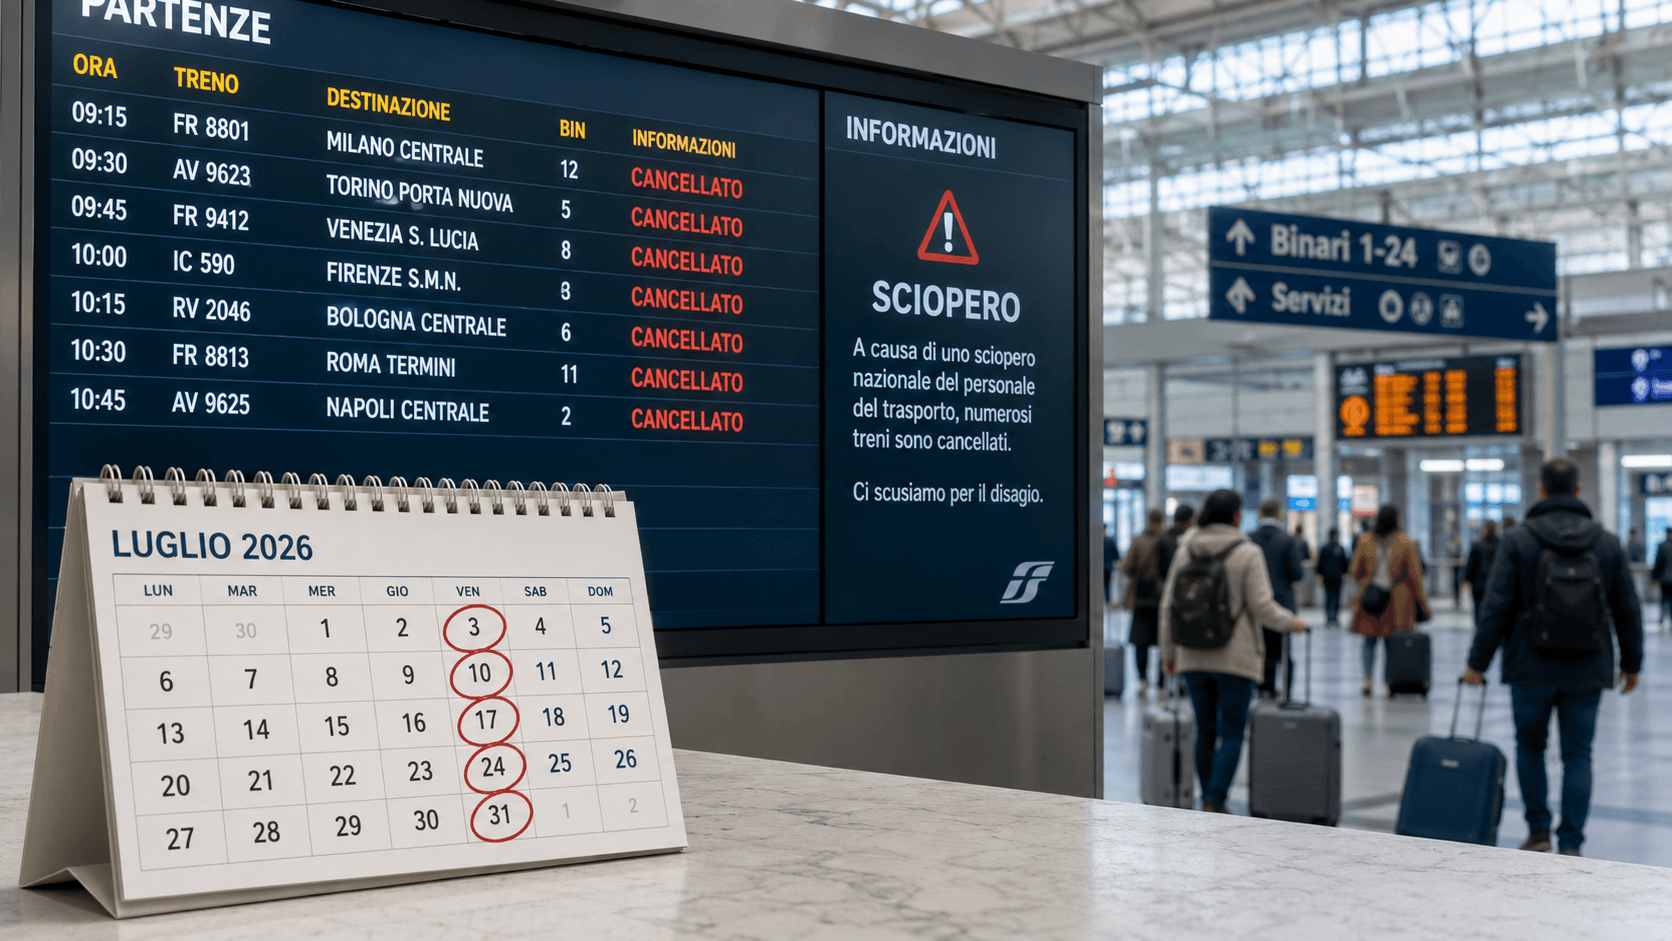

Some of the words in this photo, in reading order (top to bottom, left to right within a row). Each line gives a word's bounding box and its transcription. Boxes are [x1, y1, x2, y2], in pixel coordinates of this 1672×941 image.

[72, 52, 119, 79] ORA
[173, 66, 240, 94] TRENO
[327, 86, 451, 122] DESTINAZIONE
[559, 118, 586, 140] BIN
[632, 128, 736, 159] INFORMAZIONI
[72, 100, 127, 128] 09:15
[173, 112, 199, 136] FR
[205, 116, 249, 142] 8801
[327, 130, 395, 158] MILANO
[399, 139, 484, 168] CENTRALE
[560, 159, 579, 180] 12
[630, 166, 744, 200] CANCELLATO
[846, 115, 996, 160] INFORMAZIONI
[71, 147, 128, 174] 09:30
[172, 158, 200, 181] AV
[205, 161, 251, 186] 9623
[326, 173, 395, 200] TORINO
[399, 181, 454, 207] PORTA
[458, 188, 514, 213] NUOVA
[561, 199, 571, 219] 5
[630, 206, 744, 238] CANCELLATO
[71, 194, 127, 221] 09:45
[173, 203, 198, 227] FR
[205, 207, 249, 231] 9412
[326, 217, 404, 244] VENEZIA
[408, 225, 424, 246] S.
[430, 227, 479, 251] LUCIA
[561, 239, 571, 260] 8
[631, 245, 744, 277] CANCELLATO
[1271, 224, 1350, 262] Binari
[1360, 233, 1418, 267] 1-24
[71, 242, 127, 268] 10:00
[173, 249, 193, 272] IC
[200, 252, 235, 276] 590
[327, 261, 403, 287] FIRENZE
[408, 268, 461, 292] S.M.N.
[631, 285, 744, 315] CANCELLATO
[1272, 282, 1350, 316] Servizi
[71, 290, 126, 315] 10:15
[173, 296, 200, 319] RV
[205, 298, 251, 322] 2046
[327, 305, 416, 331] BOLOGNA
[421, 312, 507, 337] CENTRALE
[561, 322, 572, 342] 6
[631, 325, 744, 354] CANCELLATO
[871, 279, 1021, 323] SCIOPERO
[71, 338, 126, 363] 10:30
[173, 343, 198, 366] FR
[205, 345, 249, 368] 8813
[327, 351, 382, 374] ROMA
[386, 354, 456, 378] TERMINI
[561, 364, 577, 384] 11
[631, 366, 744, 393] CANCELLATO
[852, 337, 866, 357] A
[870, 342, 918, 360] causa
[922, 341, 937, 361] di
[941, 346, 970, 363] uno
[974, 345, 1036, 371] sciopero
[853, 367, 932, 391] nazionale
[935, 371, 959, 392] del
[963, 375, 1036, 397] personale
[70, 387, 126, 411] 10:45
[171, 391, 199, 413] AV
[204, 392, 250, 415] 9625
[326, 396, 395, 419] NAPOLI
[401, 399, 490, 423] CENTRALE
[561, 406, 572, 426] 2
[631, 407, 744, 433] CANCELLATO
[852, 396, 878, 418] del
[882, 399, 960, 425] trasporto,
[964, 404, 1032, 424] numerosi
[852, 428, 890, 449] treni
[894, 433, 933, 450] sono
[937, 431, 1012, 452] cancellati.
[853, 481, 869, 502] Ci
[874, 481, 946, 502] scusiamo
[950, 487, 975, 507] per
[978, 483, 986, 503] il
[990, 483, 1044, 508] disagio.
[111, 529, 232, 560] LUGLIO
[241, 532, 314, 561] 2026
[143, 584, 173, 597] LUN
[227, 584, 258, 597] MAR
[308, 585, 336, 597] MER
[386, 585, 409, 597] GIO
[455, 585, 481, 597] VEN
[523, 585, 548, 597] SAB
[587, 586, 614, 597] DOM
[150, 622, 173, 641] 29
[236, 621, 258, 639] 30
[320, 618, 330, 639] 1
[395, 617, 409, 638] 2
[467, 616, 481, 637] 3
[534, 616, 547, 636] 4
[600, 616, 612, 635] 5
[159, 670, 174, 693] 6
[244, 668, 258, 690] 7
[325, 666, 339, 688] 8
[402, 664, 415, 685] 9
[468, 662, 492, 683] 10
[535, 661, 556, 681] 11
[600, 659, 624, 679] 12
[156, 721, 185, 745] 13
[243, 718, 271, 741] 14
[324, 715, 350, 737] 15
[401, 711, 427, 733] 16
[474, 709, 497, 730] 17
[542, 706, 566, 727] 18
[607, 703, 630, 724] 19
[160, 773, 191, 798] 20
[247, 769, 273, 792] 21
[329, 764, 357, 787] 22
[407, 760, 434, 782] 23
[480, 755, 506, 778] 24
[548, 752, 572, 774] 25
[613, 748, 638, 770] 26
[165, 826, 194, 851] 27
[252, 820, 281, 844] 28
[334, 814, 362, 838] 29
[413, 808, 440, 832] 30
[487, 803, 511, 826] 31
[562, 802, 571, 820] 1
[628, 797, 639, 815] 2
